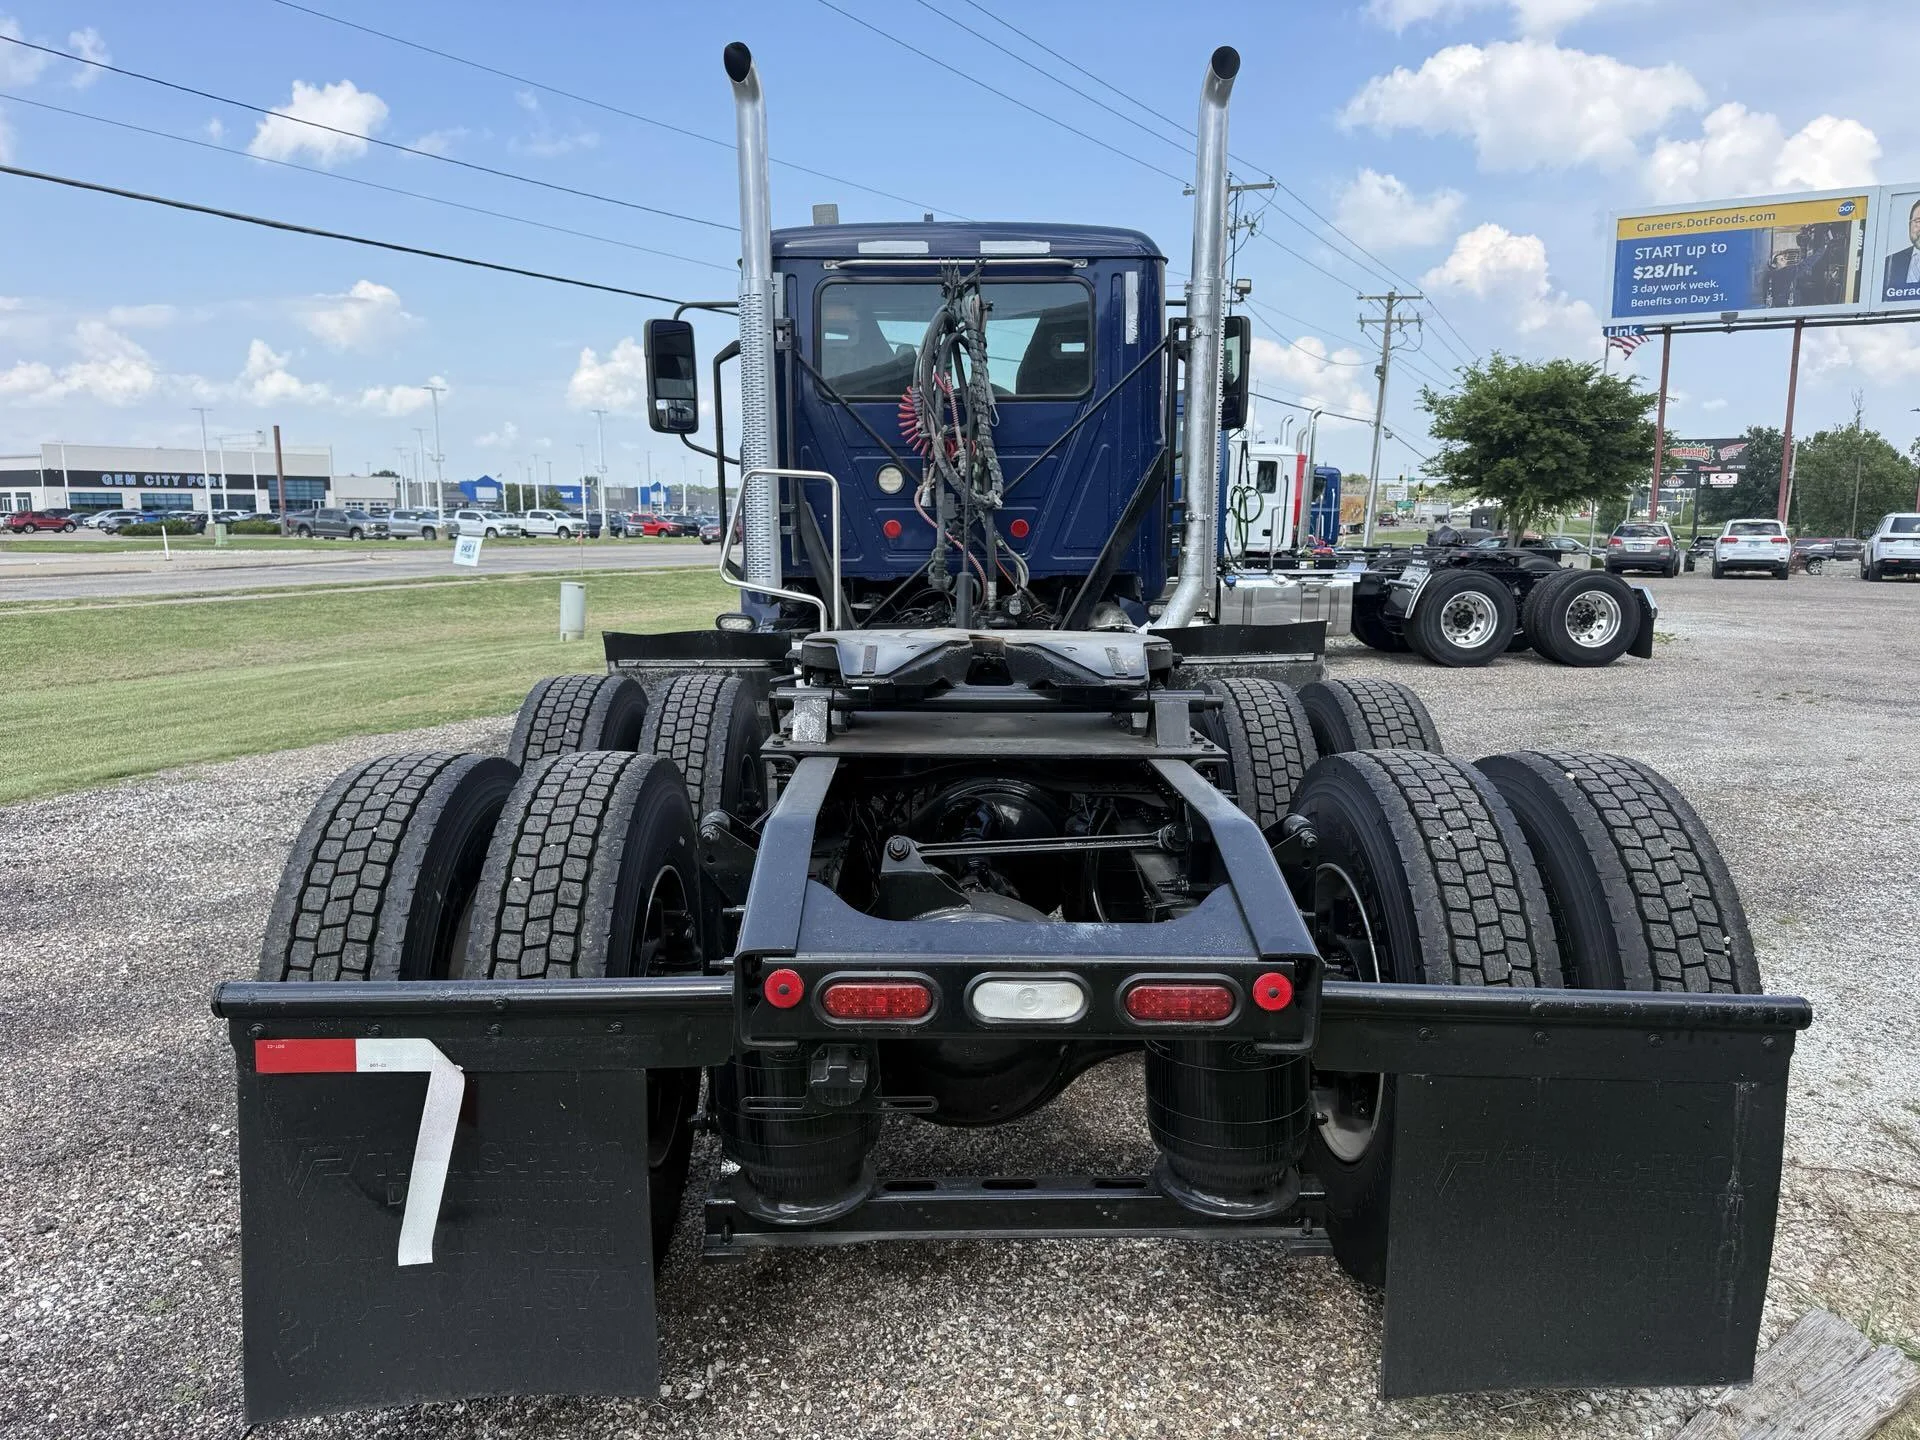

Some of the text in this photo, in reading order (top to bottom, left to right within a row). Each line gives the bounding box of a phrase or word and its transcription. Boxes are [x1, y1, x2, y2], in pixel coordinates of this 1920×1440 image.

[1636, 211, 1776, 232] Careers.DotFoods.com
[1634, 242, 1727, 260] START up to
[1633, 263, 1698, 280] $28/hr.
[1631, 279, 1719, 295] 3 day work week.
[1631, 293, 1728, 308] Benefits on Day 31.
[1607, 325, 1638, 337] Link
[101, 474, 137, 486] GEM
[144, 475, 181, 486] CITY
